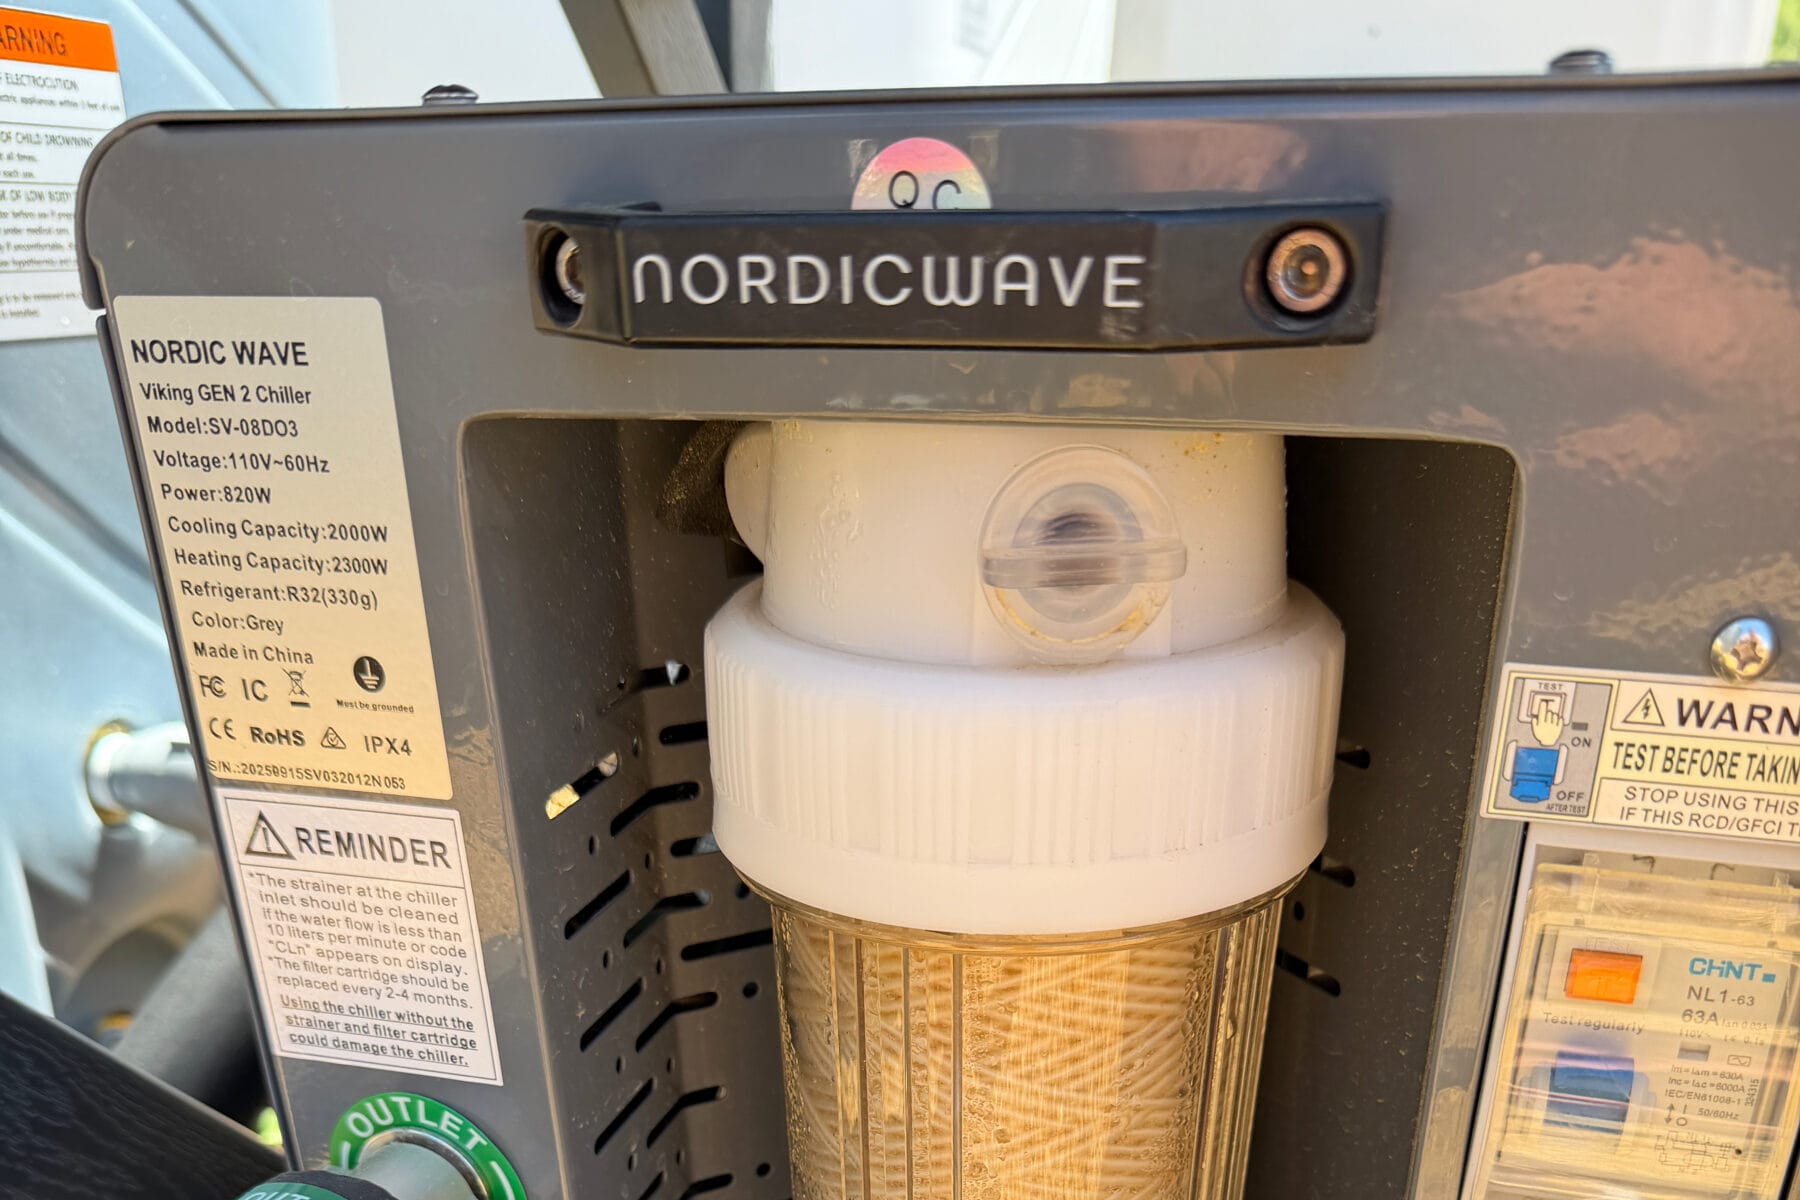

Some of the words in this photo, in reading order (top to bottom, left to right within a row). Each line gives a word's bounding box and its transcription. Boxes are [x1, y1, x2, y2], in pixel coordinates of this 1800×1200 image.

[632, 252, 1147, 309] NORDICWAVE
[130, 339, 226, 365] NORDIC
[231, 341, 309, 366] WAVE
[139, 382, 194, 405] Viking
[198, 384, 236, 402] GEN
[240, 385, 251, 402] 2
[256, 385, 311, 404] Chiller
[153, 450, 330, 474] Voltage:110V~60Hz
[161, 483, 271, 504] Power:820W
[168, 516, 237, 540] Cooling
[241, 519, 388, 543] Capacity:2000W
[174, 548, 242, 571] Heating
[246, 552, 388, 576] Capacity:2300W
[180, 579, 379, 611] Refrigerant:R32(330g)
[192, 611, 285, 636] Color:Grey
[193, 641, 239, 660] Made
[242, 645, 259, 661] in
[263, 647, 314, 665] China
[241, 679, 269, 702] IC
[1537, 682, 1563, 691] TEST
[336, 699, 358, 709] Must
[359, 701, 370, 710] be
[372, 703, 415, 714] grounded
[1677, 697, 1800, 737] WARN
[250, 726, 306, 747] RoHS
[364, 735, 413, 756] IPX4
[1571, 737, 1592, 748] ON
[1613, 741, 1656, 773] TEST
[1662, 745, 1741, 779] BEFORE
[1745, 752, 1800, 785] TAKIN
[1546, 803, 1569, 813] AFTER
[1569, 805, 1586, 814] TEST
[1556, 790, 1585, 801] OFF
[1624, 786, 1679, 806] STOP
[1683, 791, 1748, 811] USING
[1753, 797, 1799, 816] THIS
[1619, 806, 1638, 821] IF
[1642, 808, 1684, 826] THIS
[1688, 812, 1782, 836] RCD/GFCI
[295, 827, 453, 869] REMINDER
[291, 877, 353, 896] strainer
[357, 885, 373, 898] at
[377, 886, 402, 901] the
[406, 891, 458, 908] chiller
[259, 891, 296, 906] inlet
[300, 896, 357, 914] should
[362, 902, 384, 917] be
[388, 906, 459, 925] cleaned
[262, 907, 273, 920] if
[274, 909, 298, 923] the
[301, 914, 342, 929] water
[345, 917, 374, 933] flow
[378, 922, 390, 935] is
[394, 923, 425, 939] less
[428, 927, 463, 943] than
[267, 923, 285, 937] 10
[288, 925, 325, 942] liters
[328, 932, 351, 947] per
[356, 933, 407, 952] minute
[411, 940, 427, 954] or
[430, 943, 468, 959] code
[303, 960, 333, 976] filter
[337, 965, 399, 985] cartridge
[402, 974, 449, 990] should
[451, 979, 470, 993] be
[316, 947, 380, 966] appears
[384, 956, 401, 968] on
[406, 958, 469, 977] display.
[277, 975, 339, 993] replaced
[343, 984, 382, 1000] every
[386, 987, 410, 1001] 2-4
[414, 991, 473, 1010] months.
[280, 994, 320, 1012] Using
[323, 1001, 345, 1015] the
[348, 1004, 392, 1020] chiller
[396, 1010, 449, 1028] without
[451, 1017, 474, 1031] the
[1682, 1008, 1719, 1026] 63A
[286, 1014, 341, 1030] strainer
[344, 1020, 370, 1035] and
[373, 1024, 407, 1040] filter
[411, 1029, 477, 1050] cartridge
[289, 1032, 329, 1048] could
[332, 1036, 388, 1056] damage
[391, 1044, 414, 1059] the
[418, 1048, 470, 1066] chiller.
[347, 1095, 488, 1152] OUTLET
